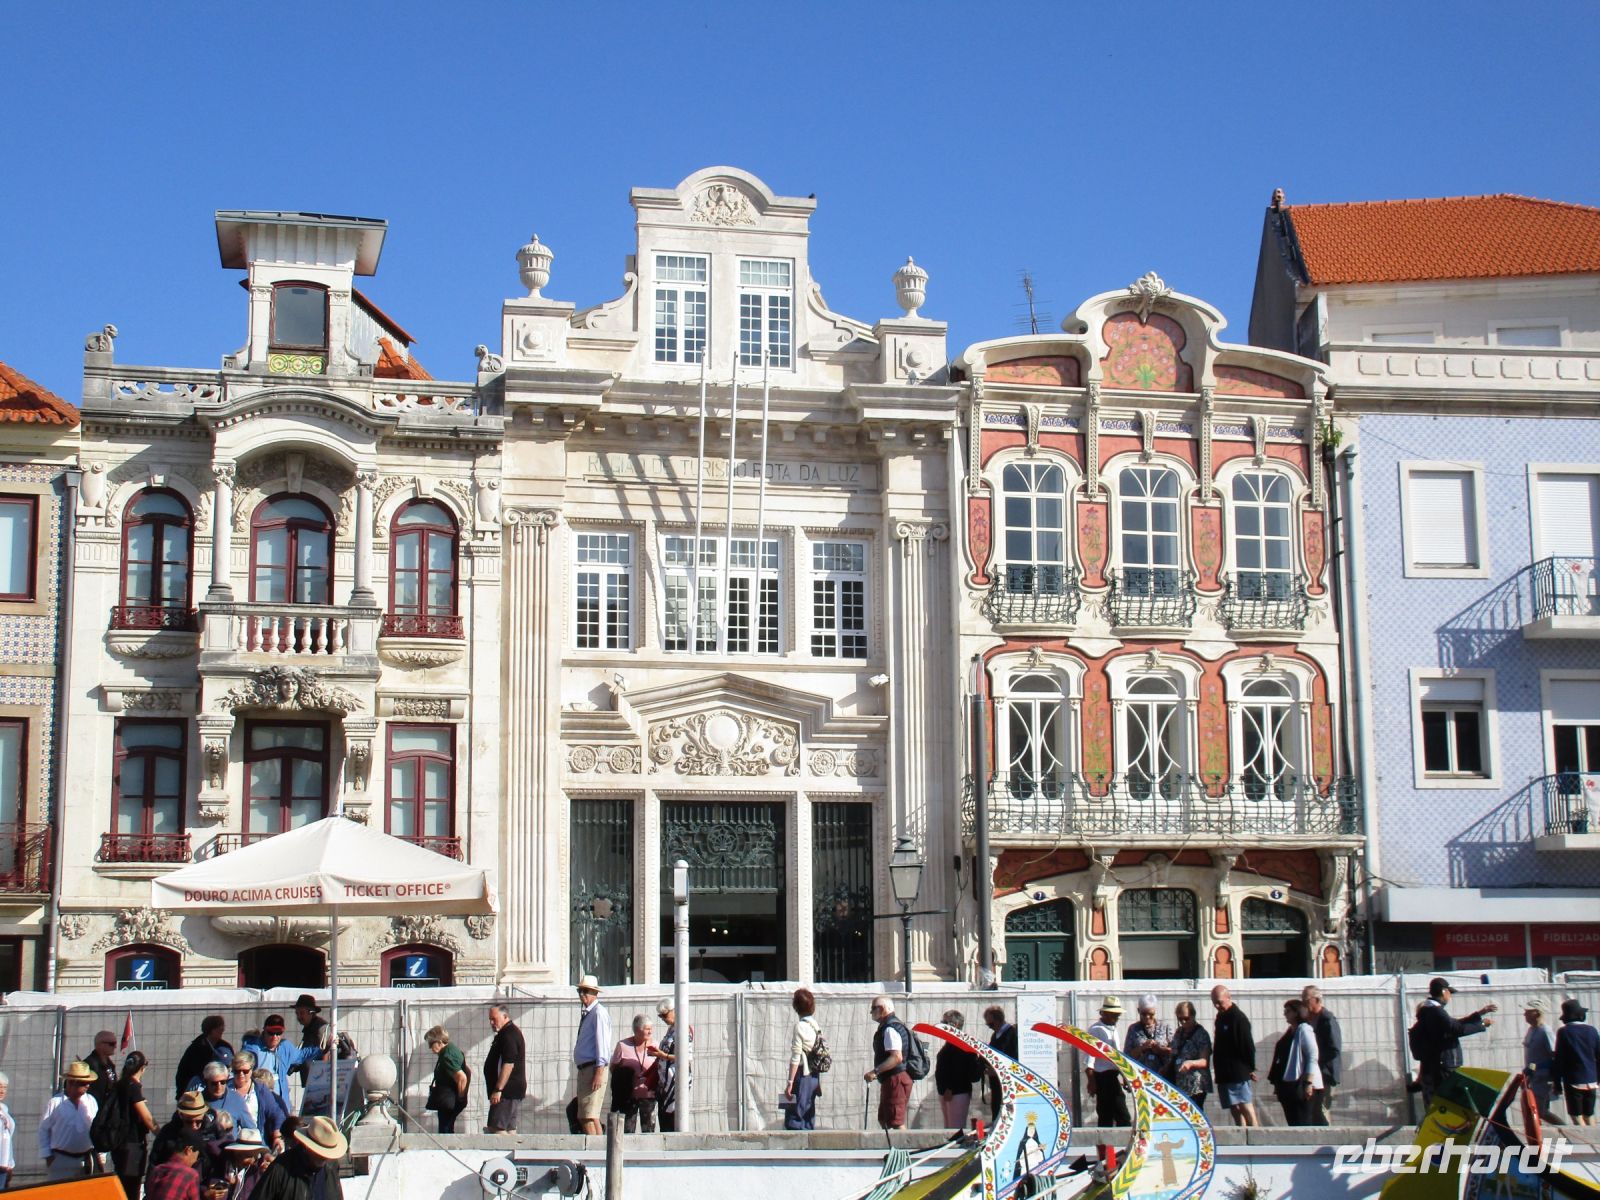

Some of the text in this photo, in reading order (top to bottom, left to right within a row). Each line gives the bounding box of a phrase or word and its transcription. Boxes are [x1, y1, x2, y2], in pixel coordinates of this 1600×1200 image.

[680, 459, 747, 479] TURISMO
[752, 463, 792, 481] ROTA
[799, 464, 821, 482] DA
[827, 465, 859, 483] LUZ
[184, 886, 323, 902] DOURO ACIMA CRUISES
[344, 884, 391, 898] TICKET
[1445, 933, 1510, 943] FIDELIDADE
